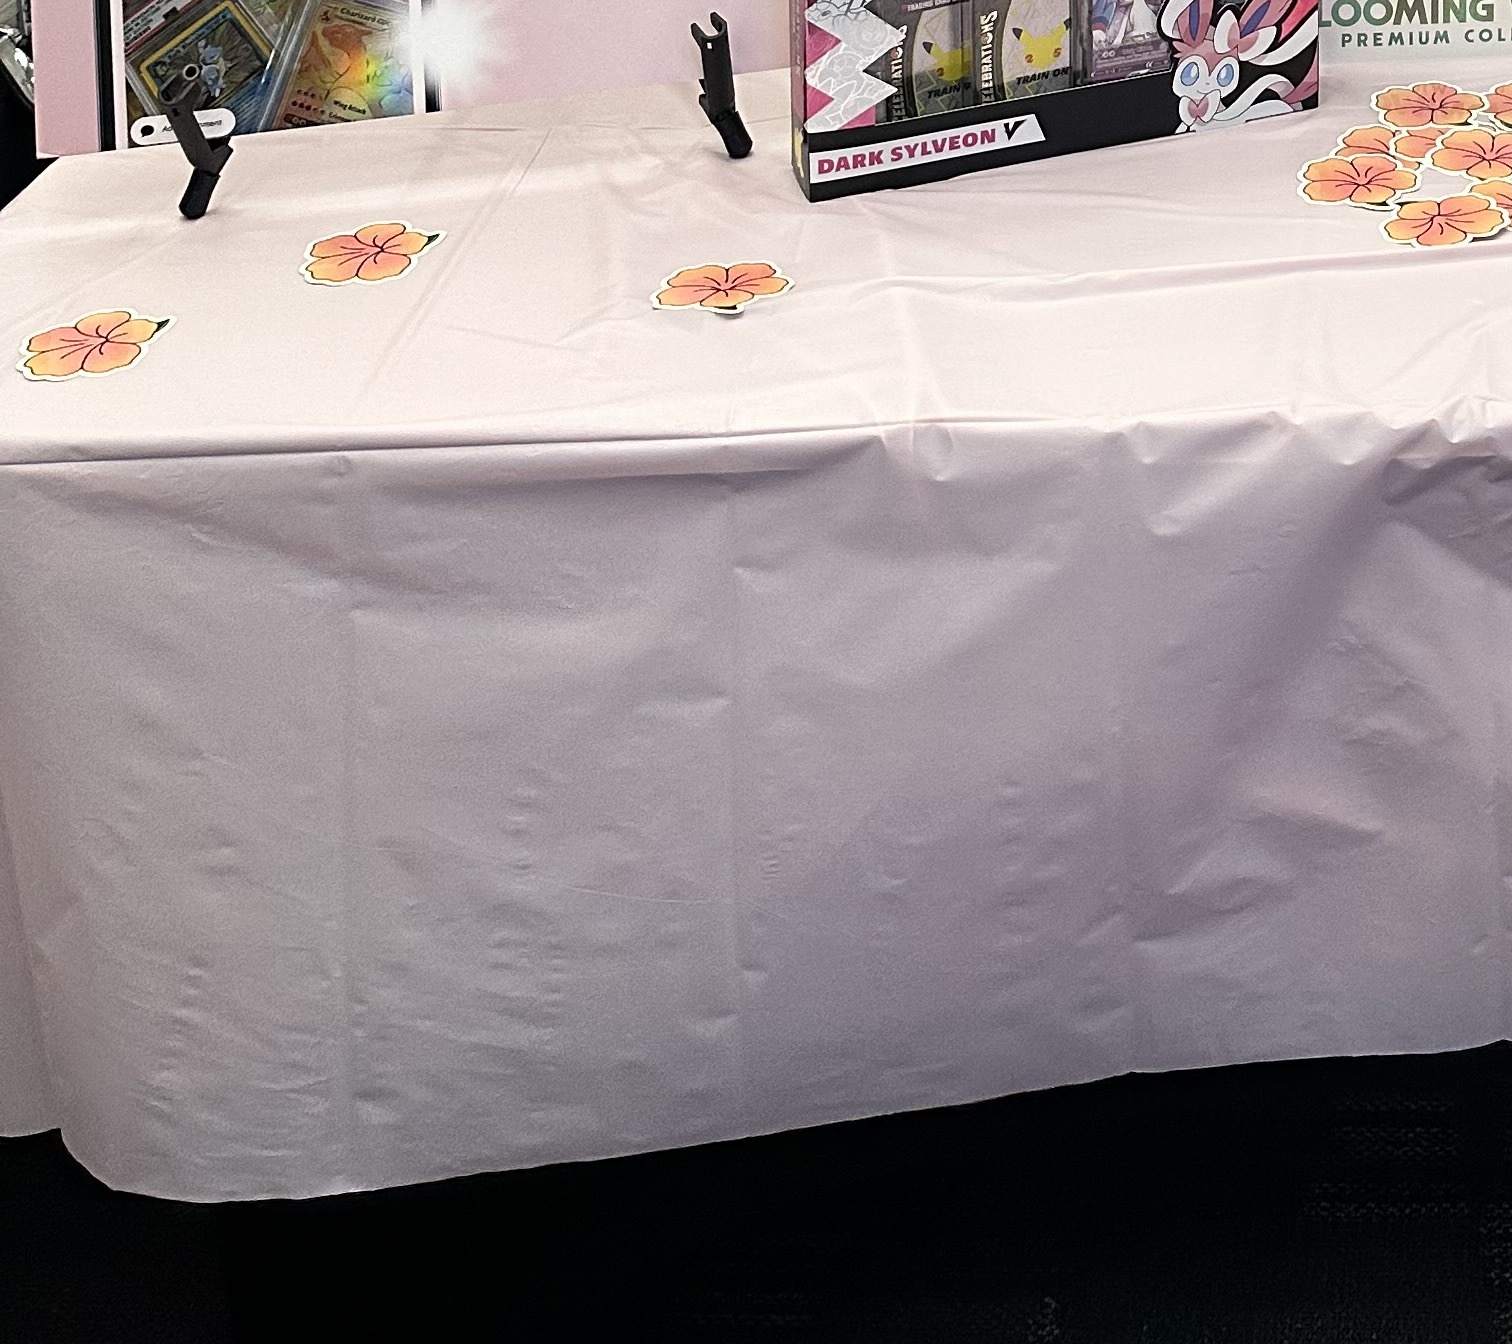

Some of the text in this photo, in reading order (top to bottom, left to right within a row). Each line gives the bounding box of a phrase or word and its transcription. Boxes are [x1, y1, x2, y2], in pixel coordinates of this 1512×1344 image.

[1340, 29, 1451, 47] PREMIUM
[1016, 70, 1050, 85] TRAIN
[818, 118, 1028, 175] DARK SYLVEON V
